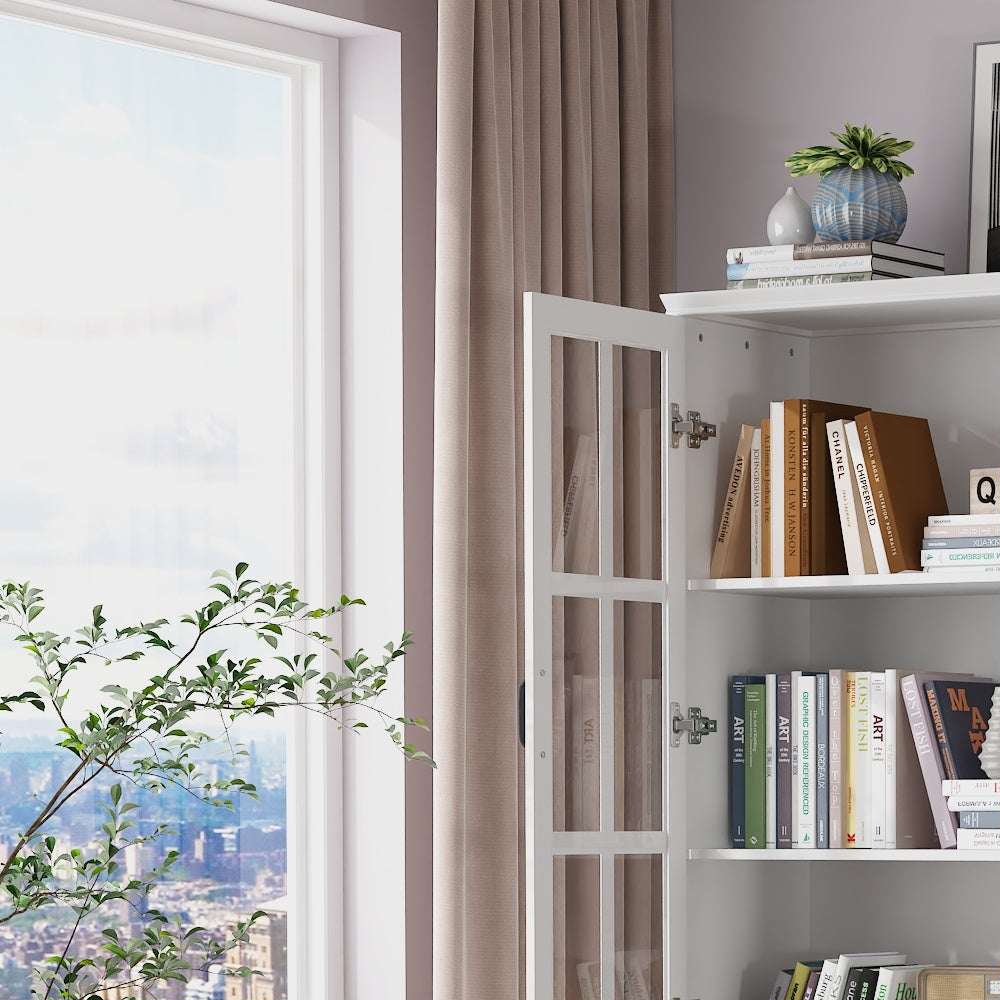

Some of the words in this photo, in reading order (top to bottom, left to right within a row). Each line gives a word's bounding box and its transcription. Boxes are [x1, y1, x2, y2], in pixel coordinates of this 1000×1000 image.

[730, 455, 744, 494] AVEDON
[788, 430, 796, 480] KONSTEN
[832, 430, 845, 480] CHANEL
[856, 463, 876, 526] CHIPPERFIELD
[863, 425, 875, 458] VICTORIA
[871, 459, 880, 483] HAGAN
[878, 490, 888, 521] INTERIOR
[886, 522, 897, 557] PORTRAITS
[976, 476, 996, 505] Q
[718, 497, 734, 543] advertising
[858, 677, 868, 715] LOST
[926, 688, 943, 732] MAKING
[938, 732, 947, 744] IT
[733, 716, 745, 743] ART
[778, 716, 790, 743] ART
[858, 719, 868, 752] FISH
[873, 714, 884, 742] ART
[902, 680, 921, 719] LOST
[914, 720, 931, 755] FISH
